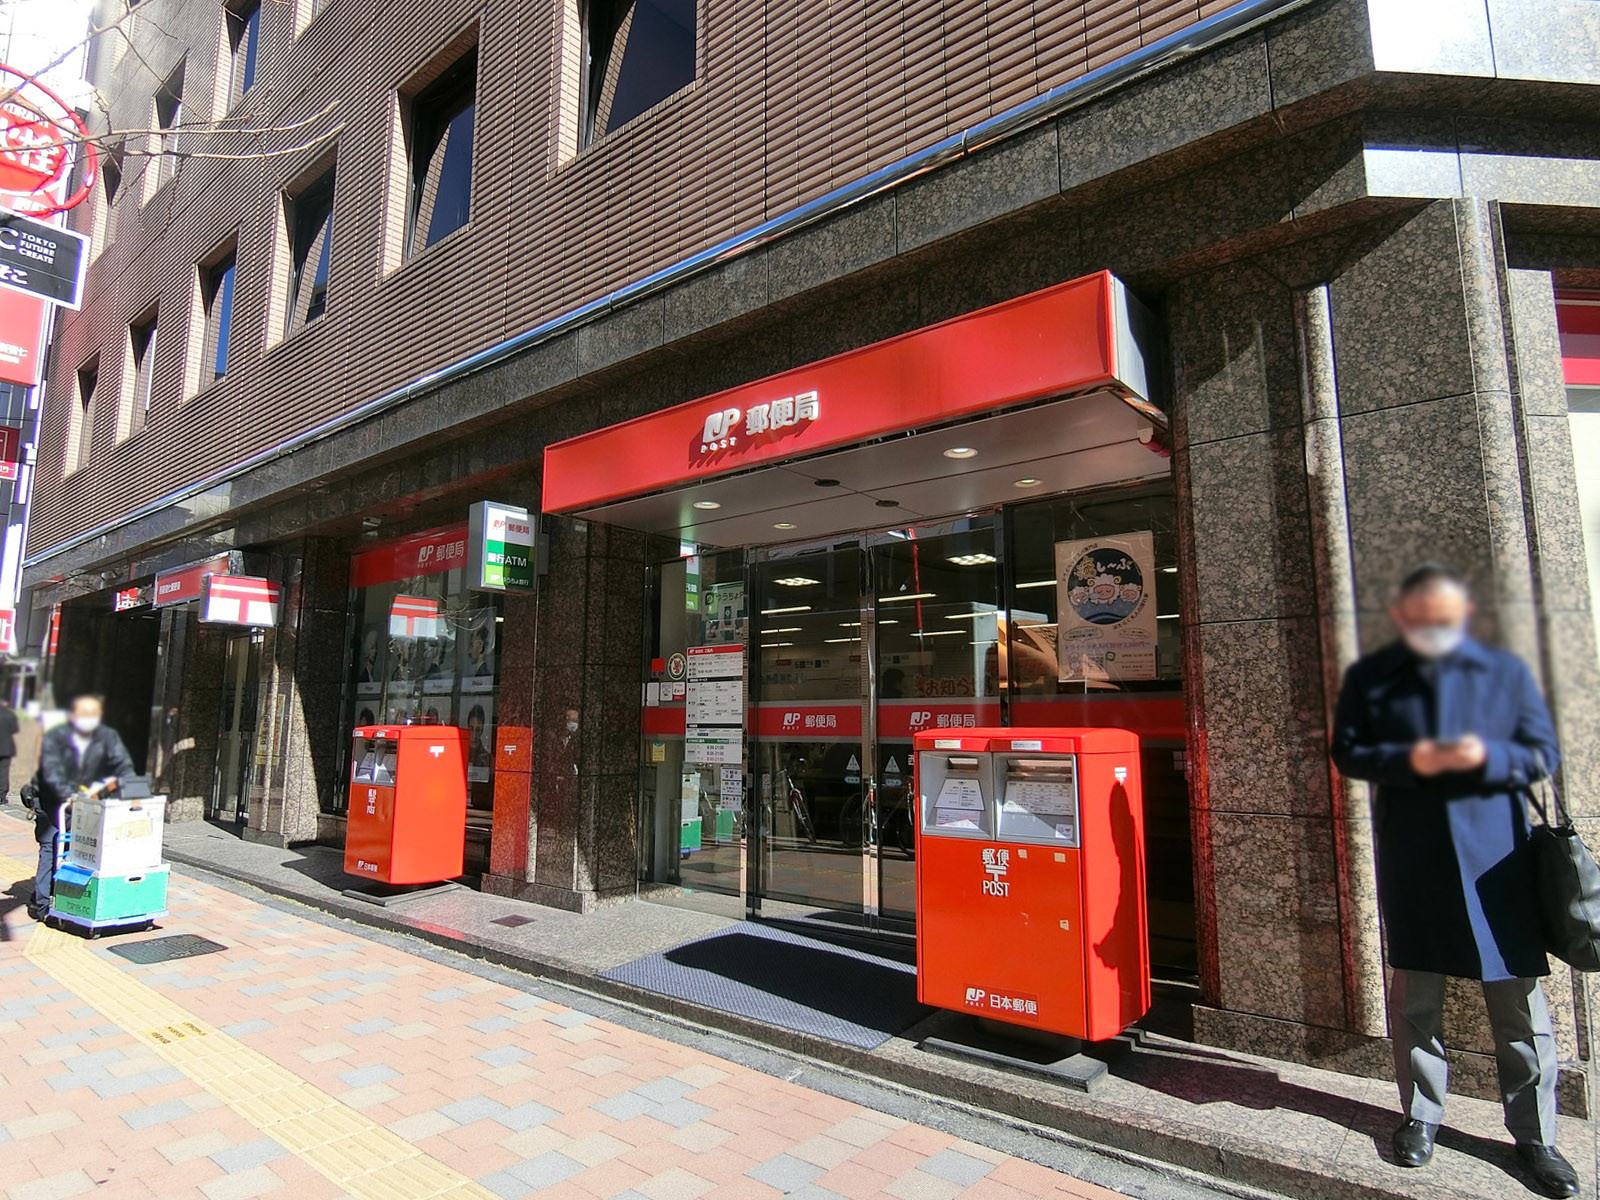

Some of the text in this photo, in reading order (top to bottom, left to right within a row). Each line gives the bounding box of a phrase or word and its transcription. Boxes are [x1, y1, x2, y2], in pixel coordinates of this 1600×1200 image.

[20, 239, 56, 257] FUTURE
[21, 231, 57, 249] TOKYO
[19, 248, 54, 264] CREATE
[746, 390, 819, 435] 郵便局
[700, 437, 737, 454] POST
[508, 523, 530, 535] 郵便局
[436, 541, 465, 562] 郵便局
[805, 714, 837, 728] 郵便局
[936, 713, 976, 728] 郵便局
[982, 848, 1010, 867] 郵便
[982, 880, 1010, 897] POST
[990, 994, 1038, 1015] 日本郵便
